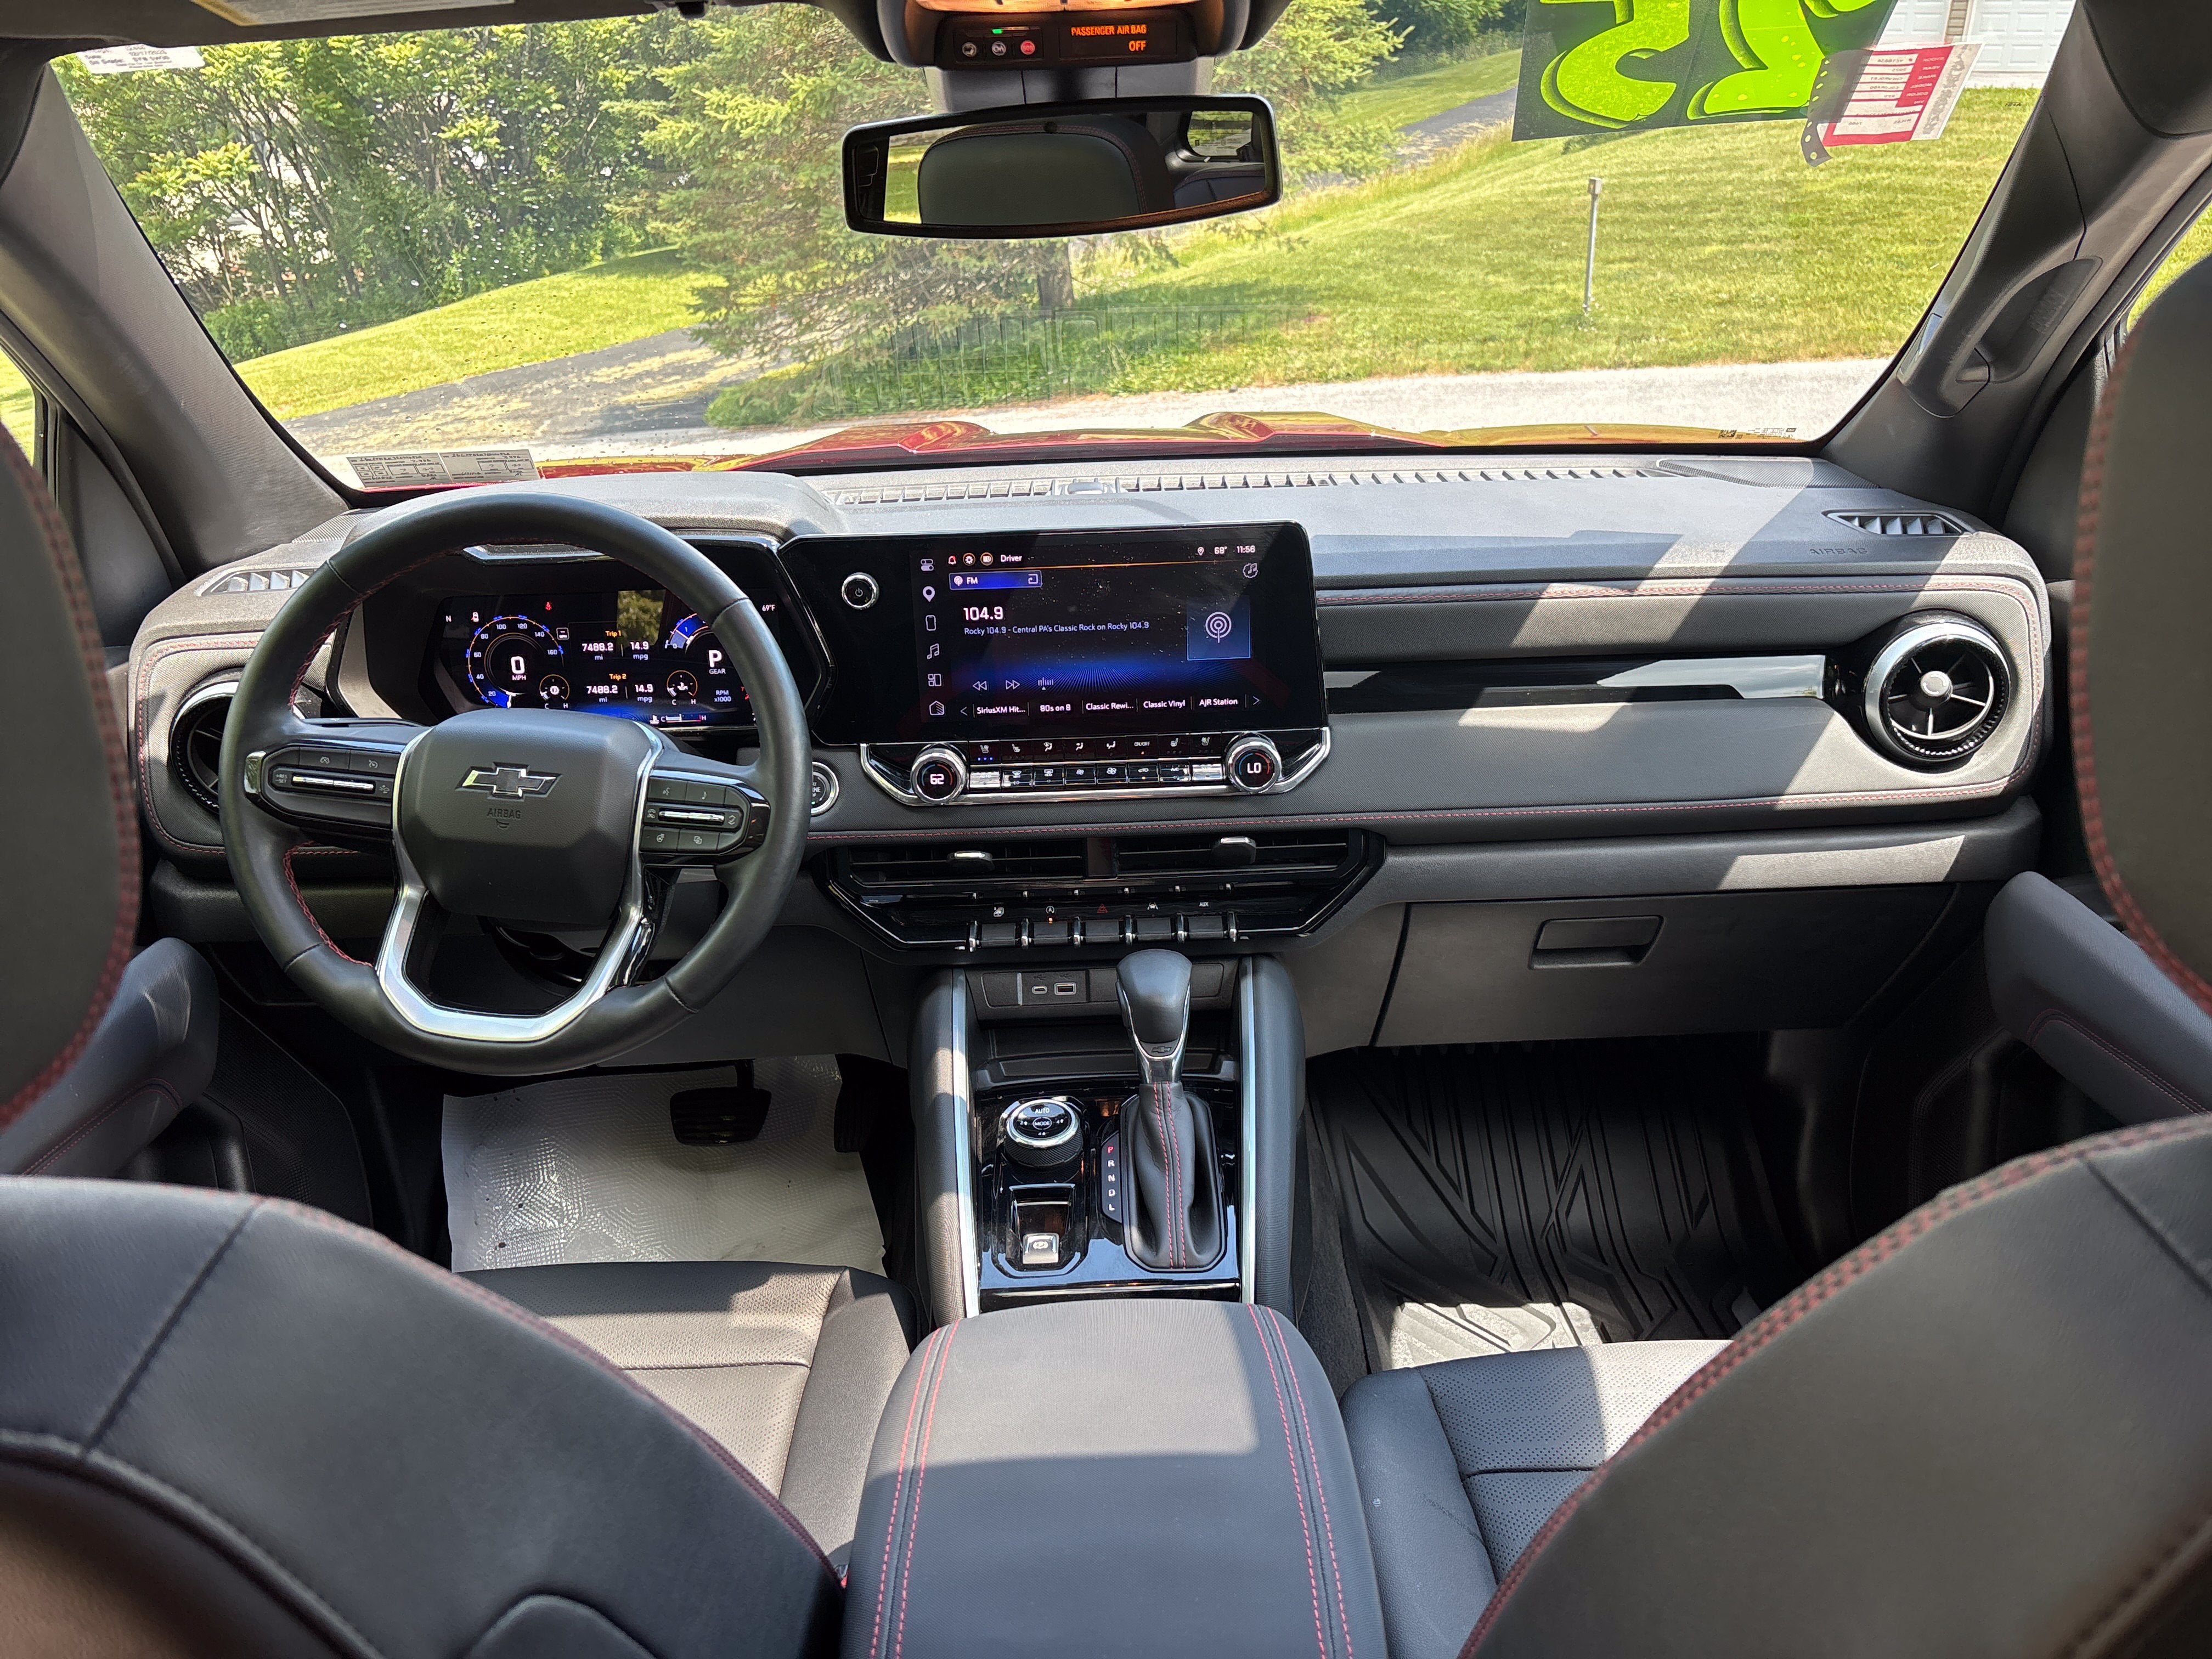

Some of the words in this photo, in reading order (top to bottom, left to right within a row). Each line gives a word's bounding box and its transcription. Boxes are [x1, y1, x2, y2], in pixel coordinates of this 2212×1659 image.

[1071, 25, 1115, 36] PASSENGER
[1117, 25, 1130, 34] AIR
[1131, 24, 1147, 34] BAG
[1128, 40, 1147, 52] OFF
[1000, 554, 1023, 563] Driver
[966, 577, 978, 585] FM
[963, 606, 1004, 621] 104.9
[964, 627, 985, 636] Rocky
[1012, 625, 1037, 634] Central
[1039, 624, 1053, 633] PA's
[1053, 623, 1077, 632] Classic
[1079, 623, 1096, 631] Rock
[1107, 622, 1128, 631] Rocky
[1130, 621, 1149, 629] 104.9
[582, 642, 614, 652] 7488.2
[630, 641, 649, 650] 14.9
[708, 650, 723, 668] P
[511, 656, 526, 674] 0
[586, 685, 618, 694] 7488.2
[634, 684, 653, 693] 14.9
[1168, 699, 1186, 708] Vinyl
[1199, 699, 1212, 707] AJR
[1213, 698, 1238, 706] Station
[977, 706, 1008, 714] SiriusXM
[1247, 762, 1261, 774] LO
[930, 774, 944, 785] 62
[487, 808, 521, 819] AIRBAG
